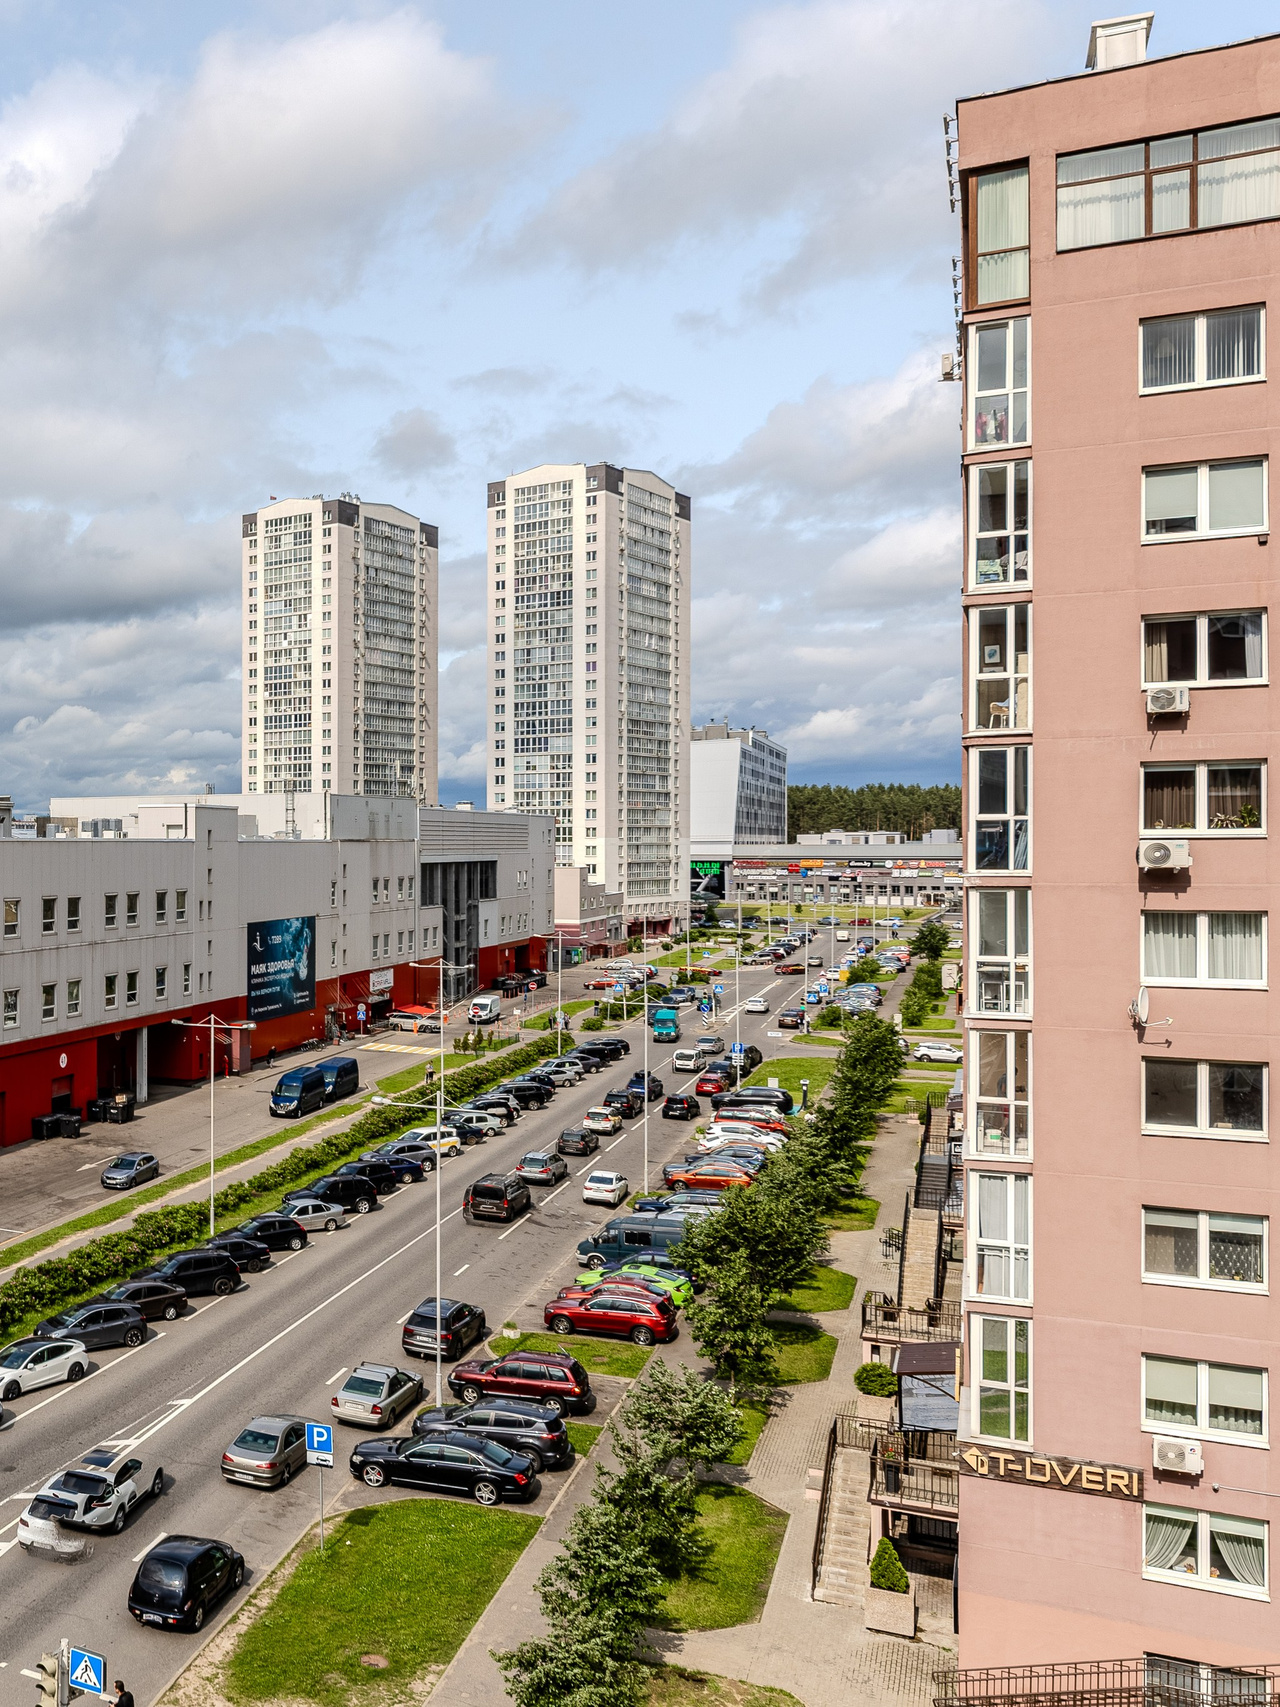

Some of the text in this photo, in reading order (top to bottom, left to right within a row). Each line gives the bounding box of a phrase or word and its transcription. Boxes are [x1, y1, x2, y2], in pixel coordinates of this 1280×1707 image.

[251, 958, 295, 975] МАЯК ЗДОРОВЬЯ
[313, 1427, 328, 1449] P
[988, 1451, 1139, 1497] T-DVERI
